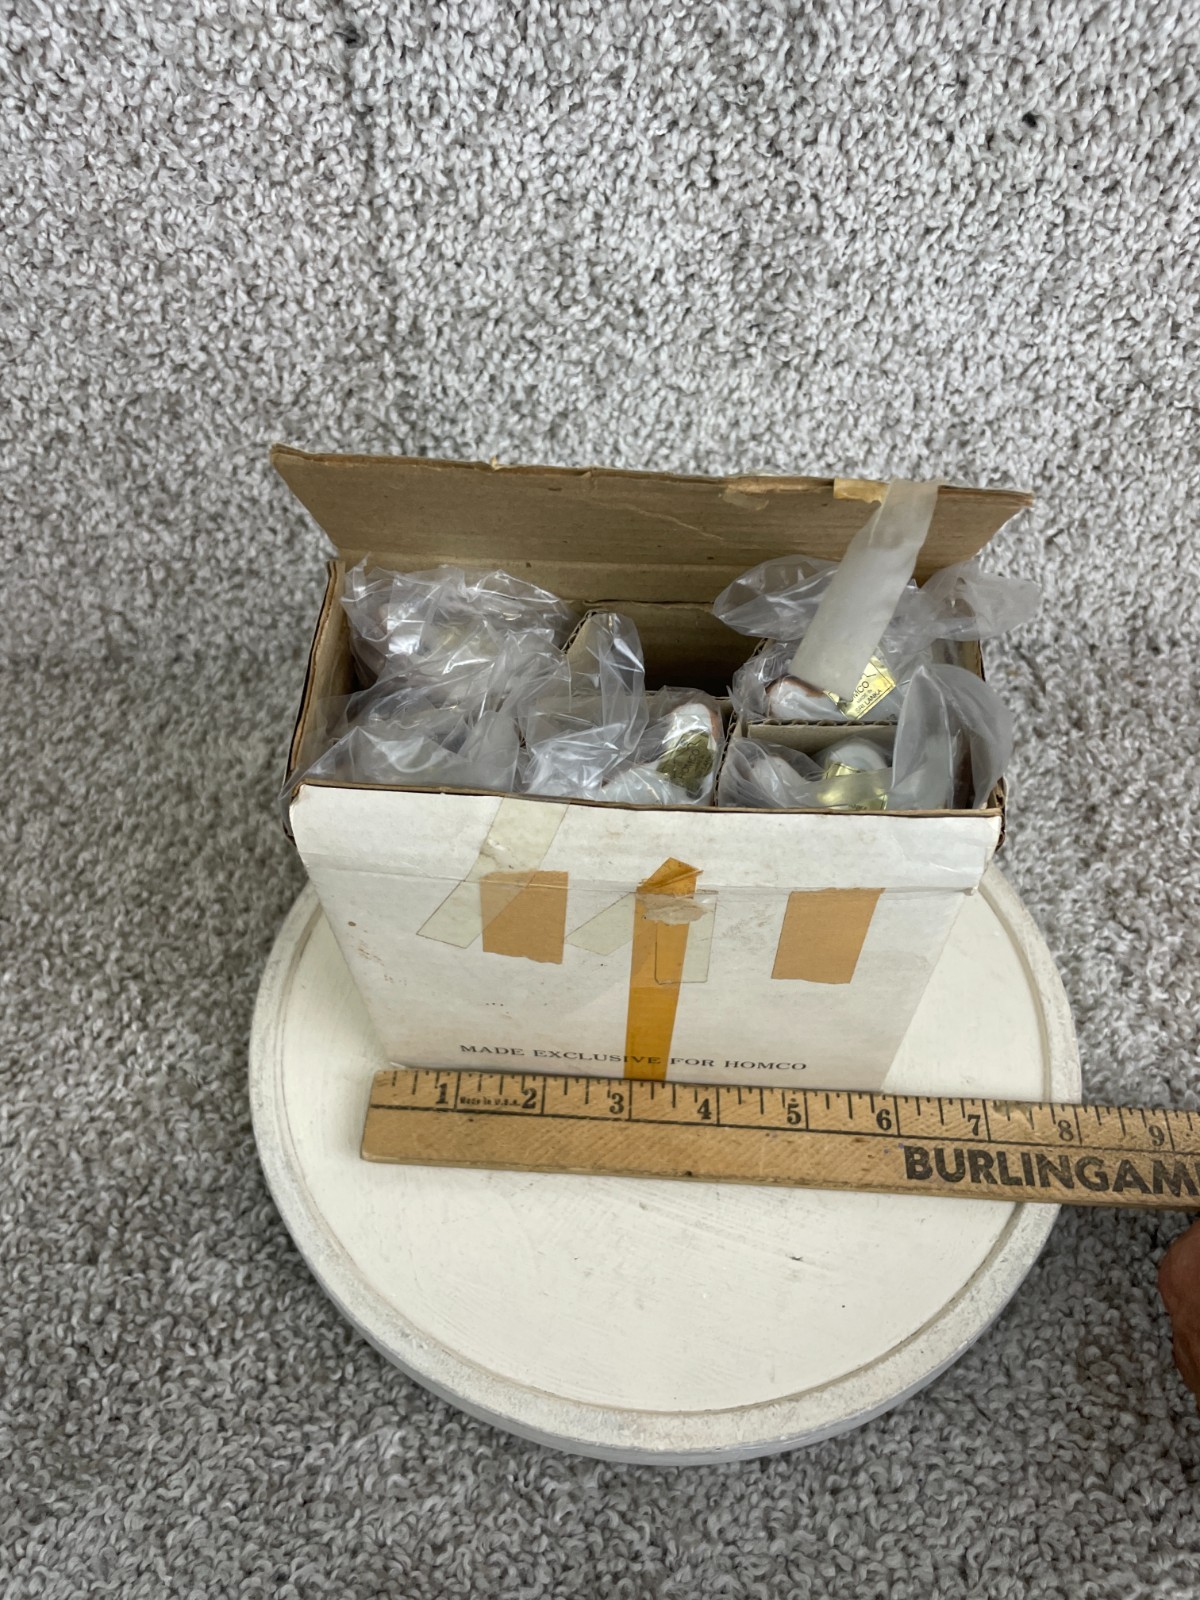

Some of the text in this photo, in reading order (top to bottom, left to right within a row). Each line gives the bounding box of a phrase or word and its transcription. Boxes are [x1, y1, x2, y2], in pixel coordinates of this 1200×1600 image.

[864, 688, 881, 706] LANKA
[460, 1045, 808, 1071] MADE EXCLUSIVE FOR HOMCO
[435, 1083, 1165, 1147] 1 2 3 4 5 6 7 8 9
[903, 1144, 1200, 1198] BURLINGAM
